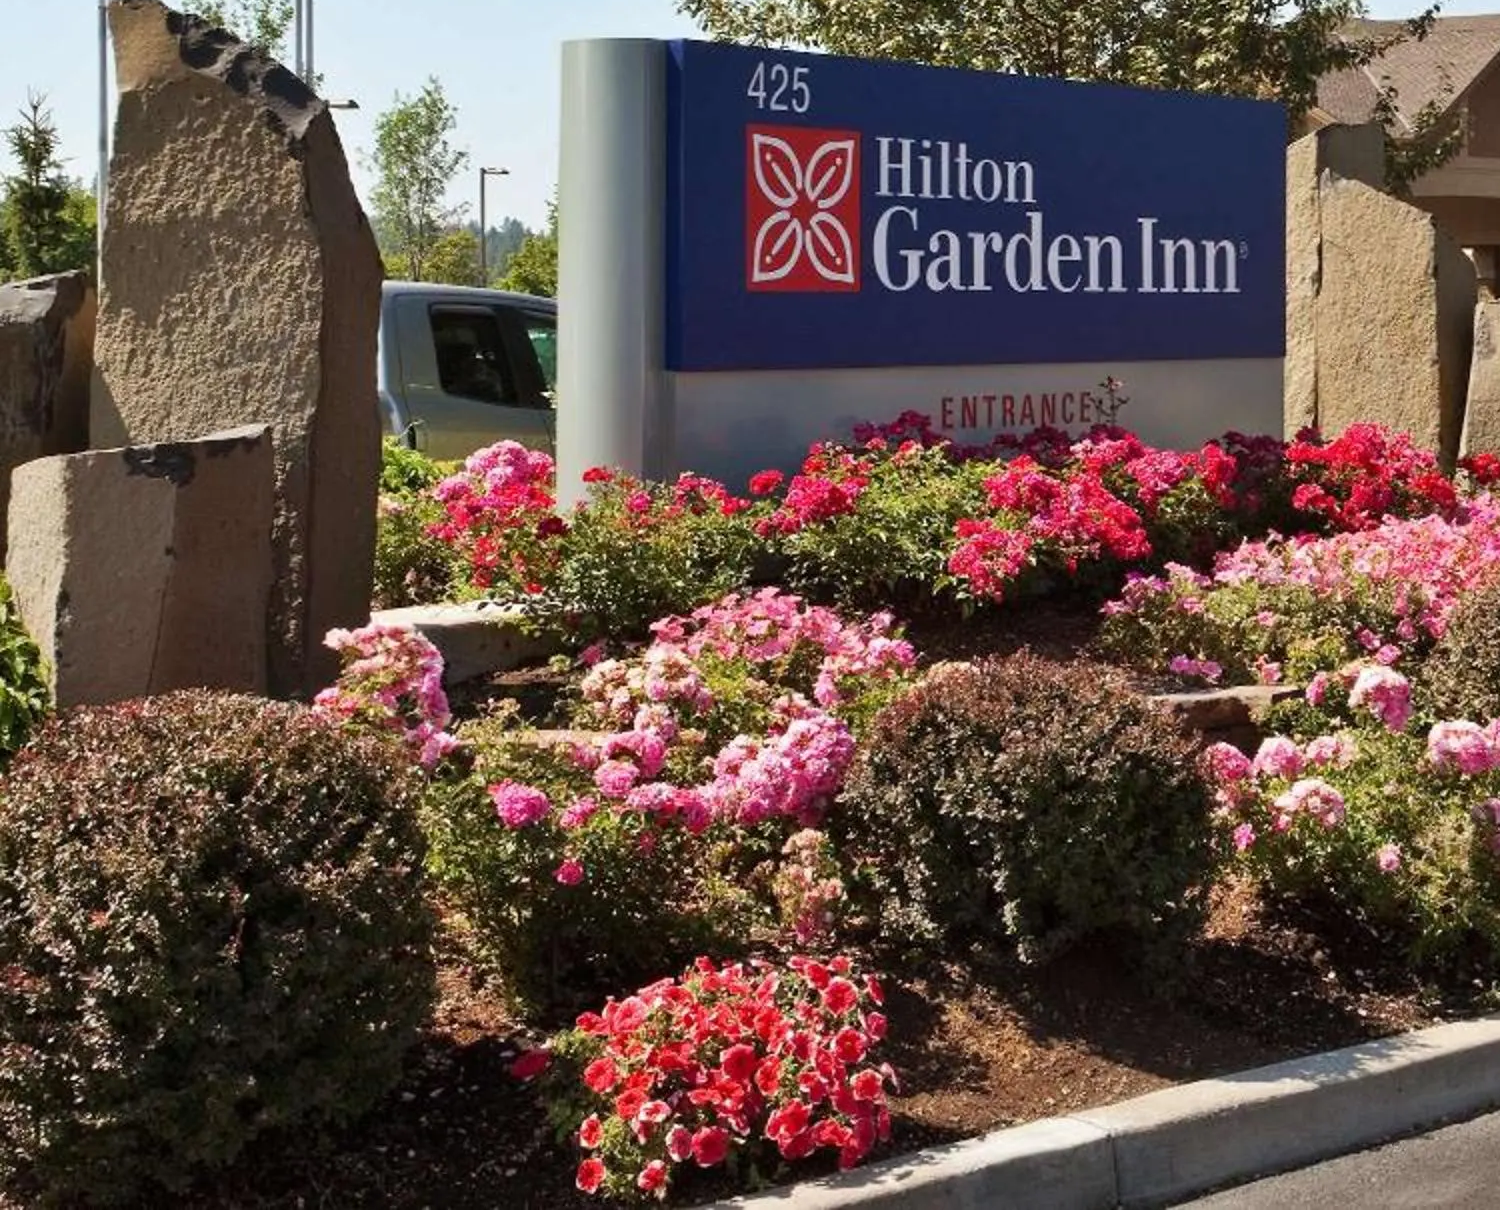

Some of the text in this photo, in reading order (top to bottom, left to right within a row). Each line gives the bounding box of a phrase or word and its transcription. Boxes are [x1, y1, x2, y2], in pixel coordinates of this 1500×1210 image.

[747, 61, 811, 113] 425
[874, 136, 1037, 203] Hilton
[872, 205, 1241, 293] Garden Inn
[941, 392, 1092, 429] ENTRANCE
